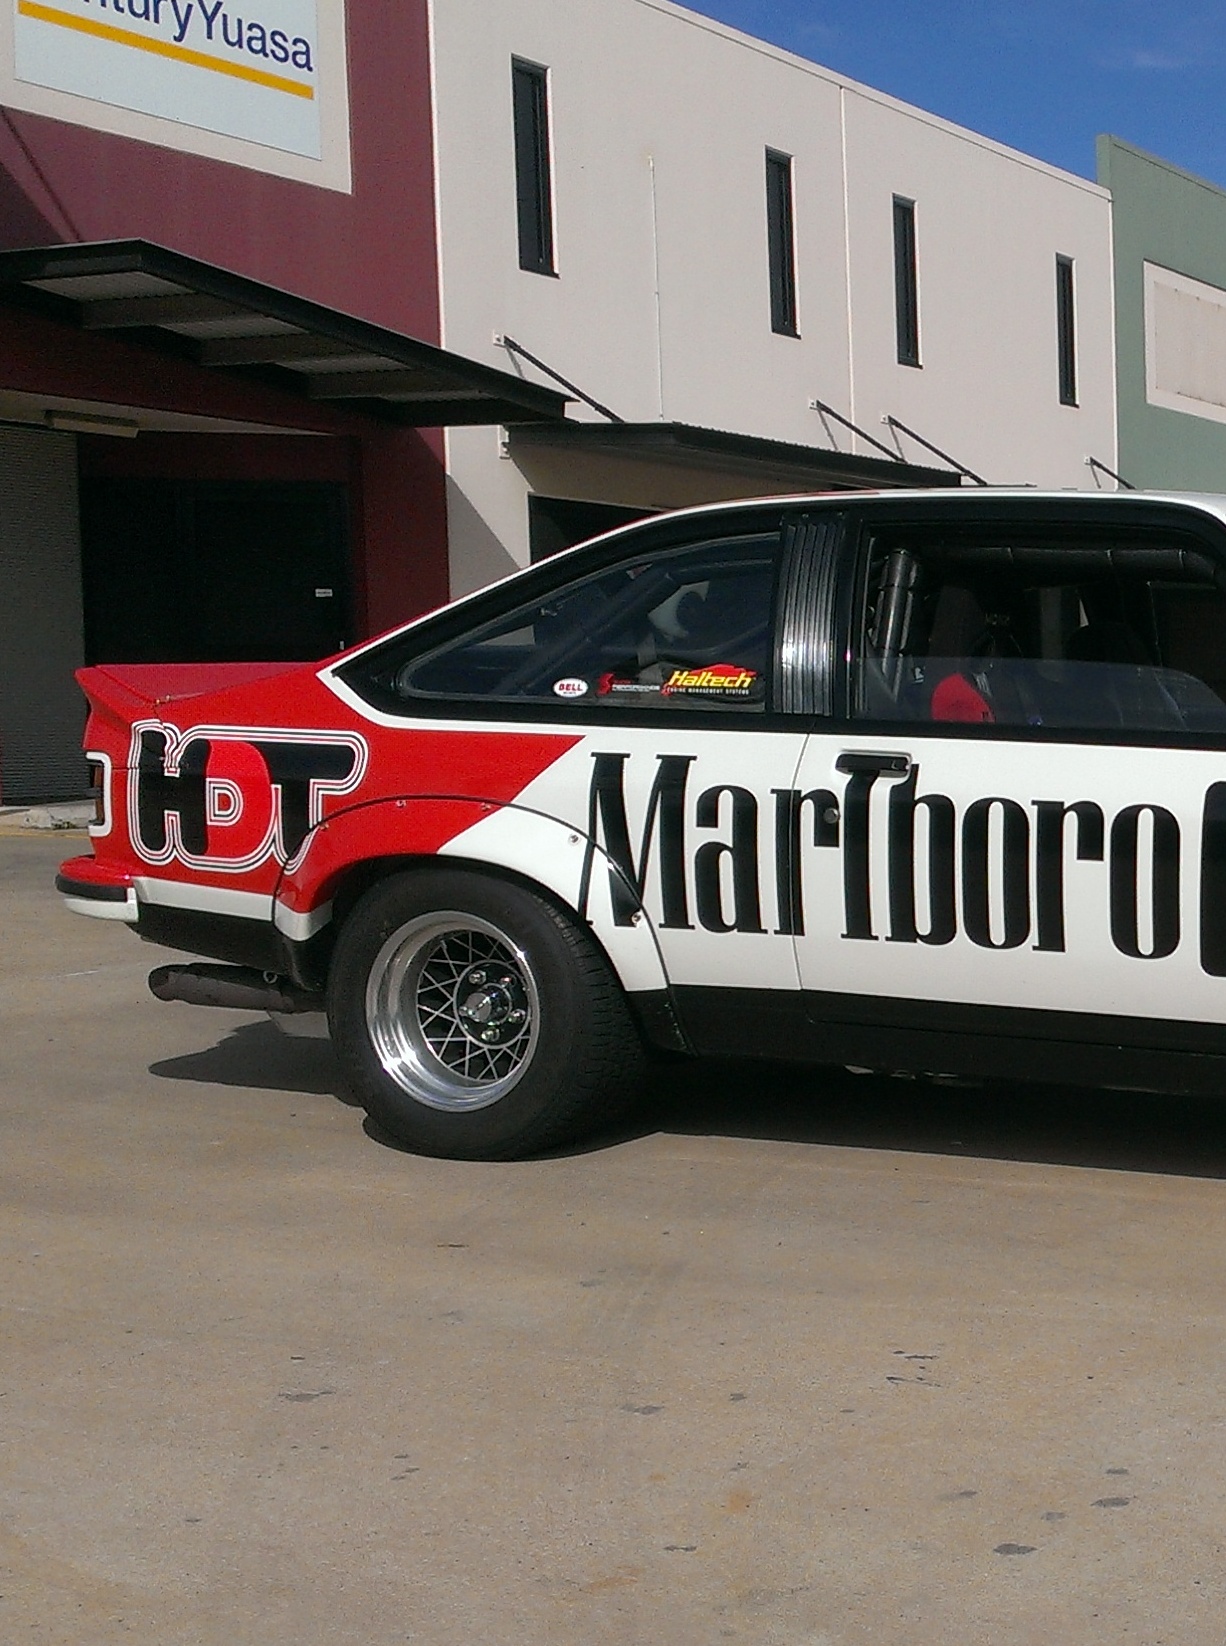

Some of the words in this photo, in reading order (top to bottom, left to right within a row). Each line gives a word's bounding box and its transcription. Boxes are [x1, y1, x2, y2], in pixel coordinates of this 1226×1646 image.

[84, 0, 313, 72] uryYuasa
[558, 683, 583, 691] BELL
[668, 670, 752, 688] Haltech
[130, 722, 366, 870] HDT
[579, 752, 1180, 959] Marlboro
